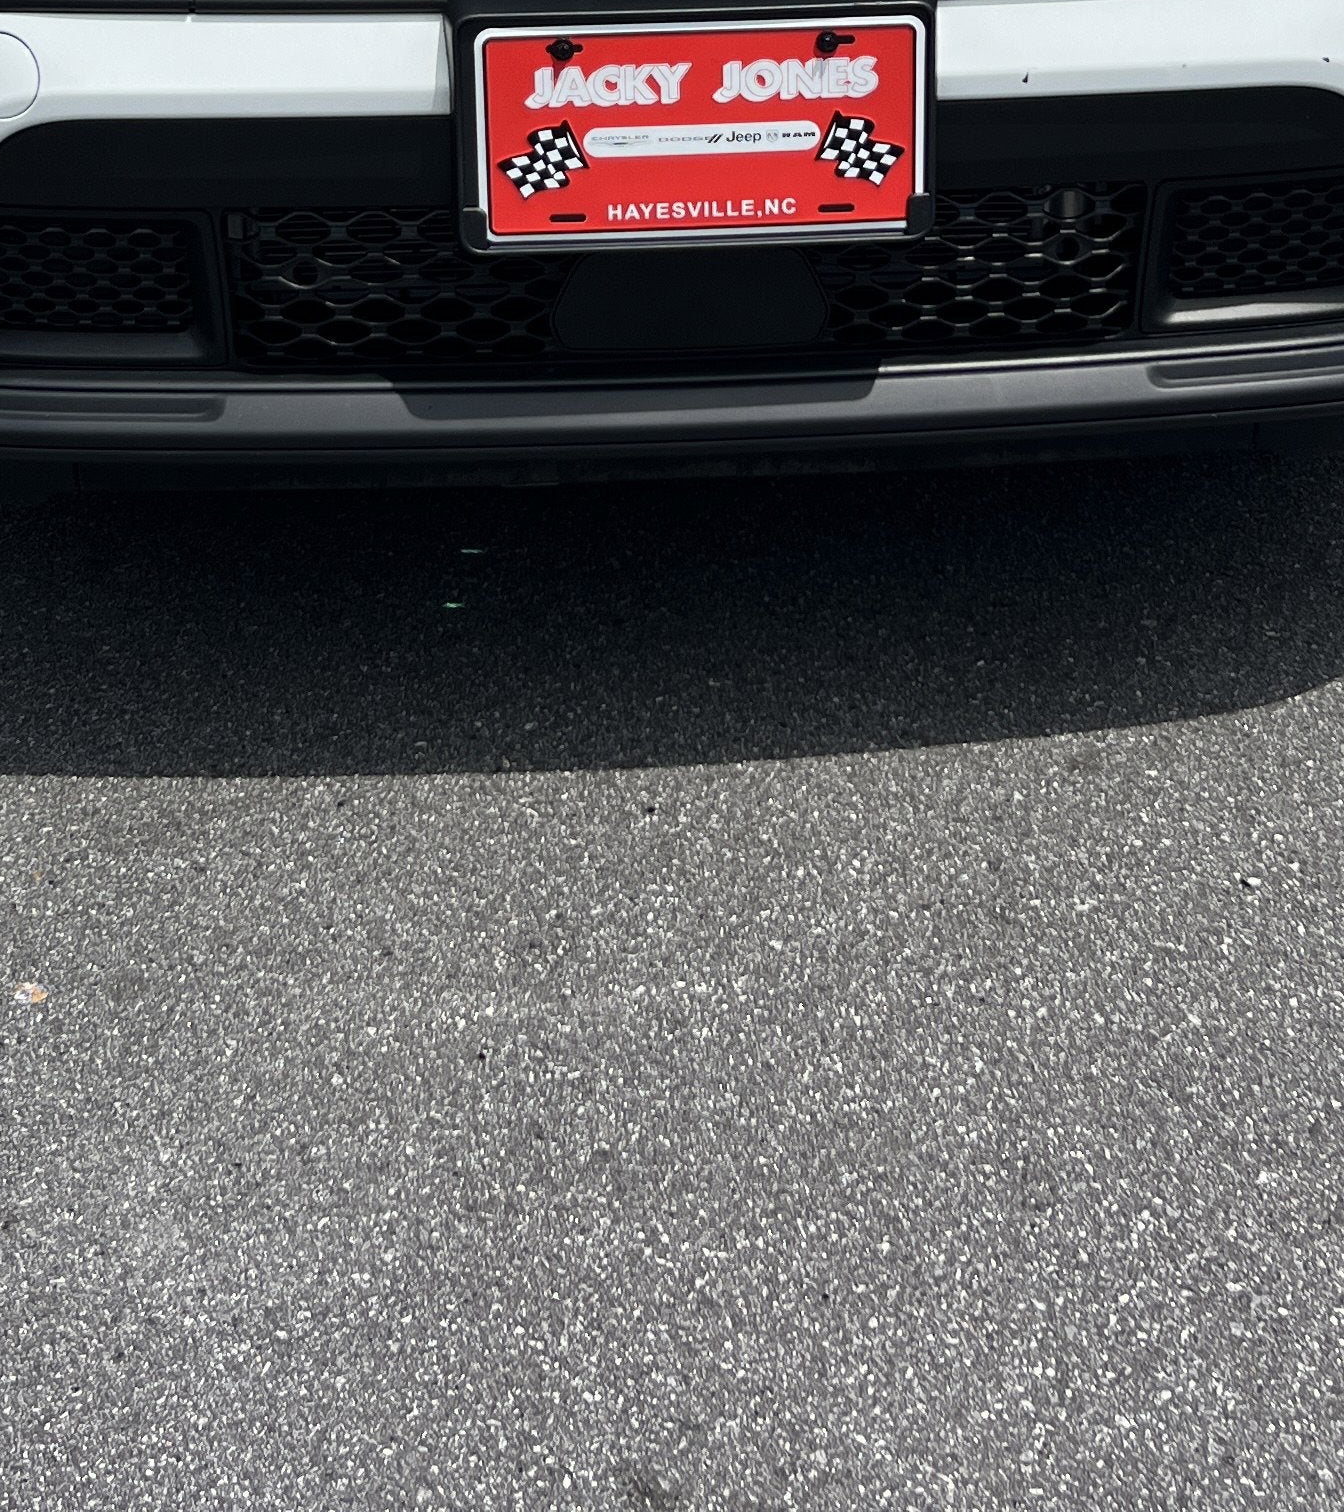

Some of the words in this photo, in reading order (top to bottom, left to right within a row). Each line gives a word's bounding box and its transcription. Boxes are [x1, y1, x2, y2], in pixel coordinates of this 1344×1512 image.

[524, 62, 693, 110] JACKY
[712, 55, 879, 104] JONES
[725, 131, 762, 144] Jeep
[782, 130, 816, 138] RAM
